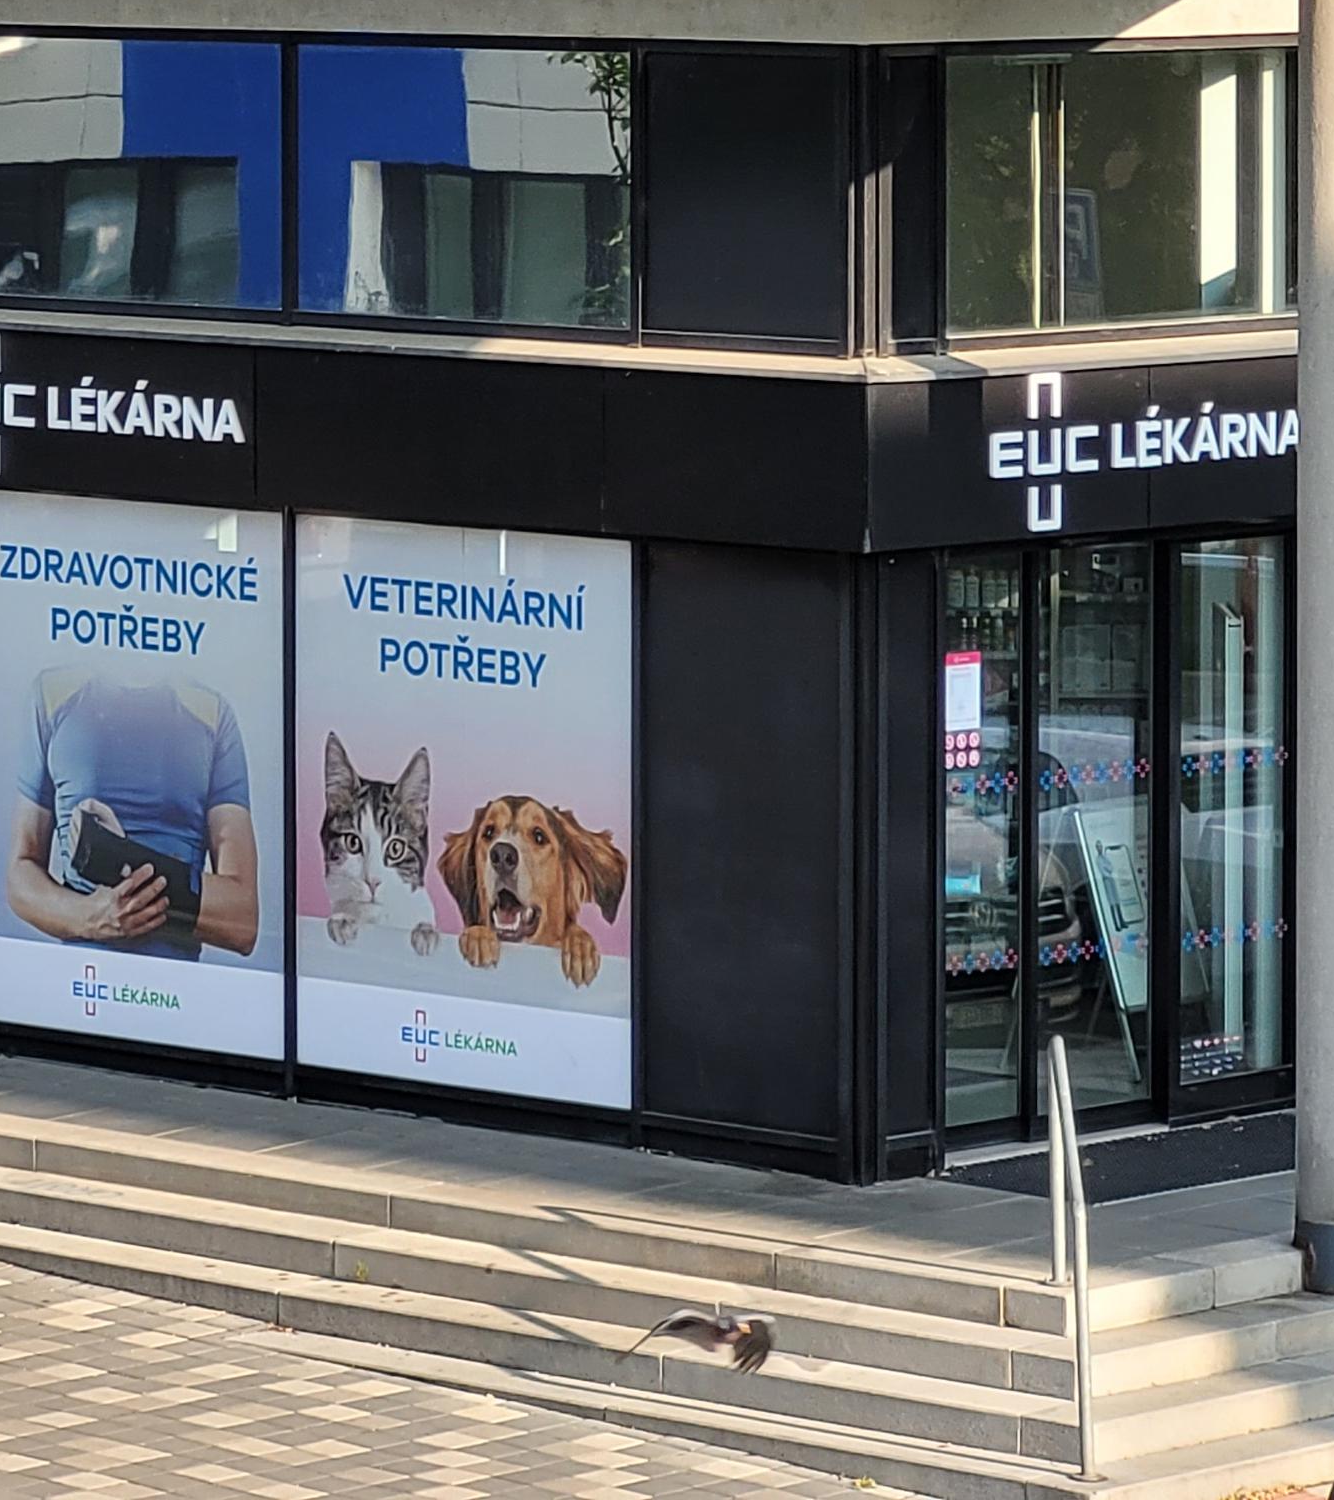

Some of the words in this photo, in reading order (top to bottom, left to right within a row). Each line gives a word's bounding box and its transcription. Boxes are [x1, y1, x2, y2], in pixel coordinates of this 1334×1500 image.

[47, 376, 246, 443] LÉKÁRNA
[989, 425, 1099, 479] EUC
[1110, 401, 1299, 469] LÉKÁRNA
[0, 544, 258, 602] ZDRAVOTNICKÉ
[51, 604, 205, 655] POTŘEBY
[343, 573, 586, 631] VETERINÁRNÍ
[380, 634, 547, 688] POTŘEBY
[72, 981, 108, 1000] EUC
[112, 983, 181, 1010] LÉKÁRNA
[401, 1026, 440, 1046] EUC
[445, 1029, 518, 1057] LÉKÁRNA
